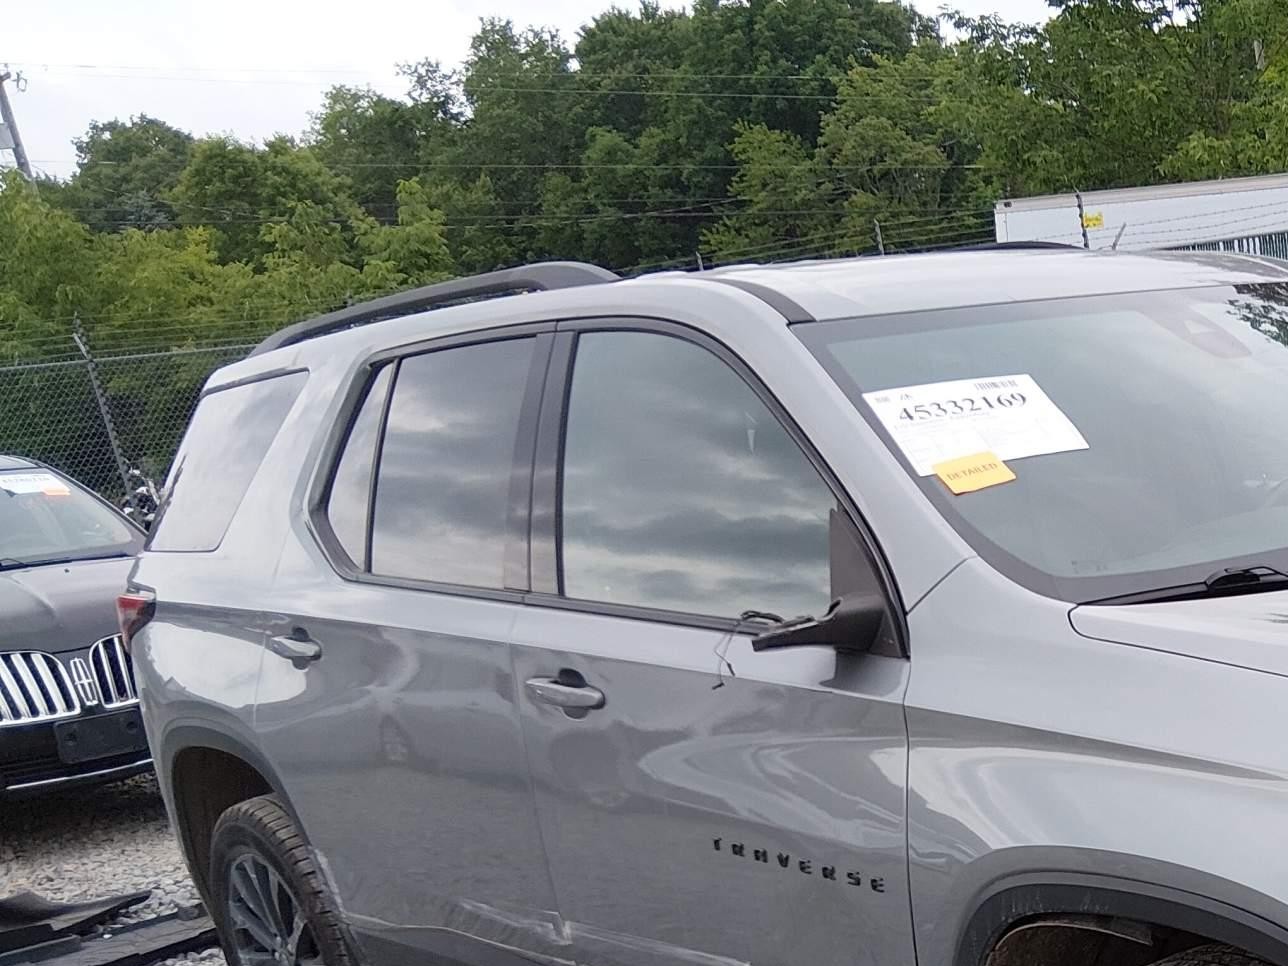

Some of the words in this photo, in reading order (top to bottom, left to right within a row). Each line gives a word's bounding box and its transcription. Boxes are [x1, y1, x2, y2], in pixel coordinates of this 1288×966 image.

[899, 392, 1027, 421] 45332169
[946, 462, 998, 481] DETAILED
[712, 837, 886, 893] TRAVERSE
